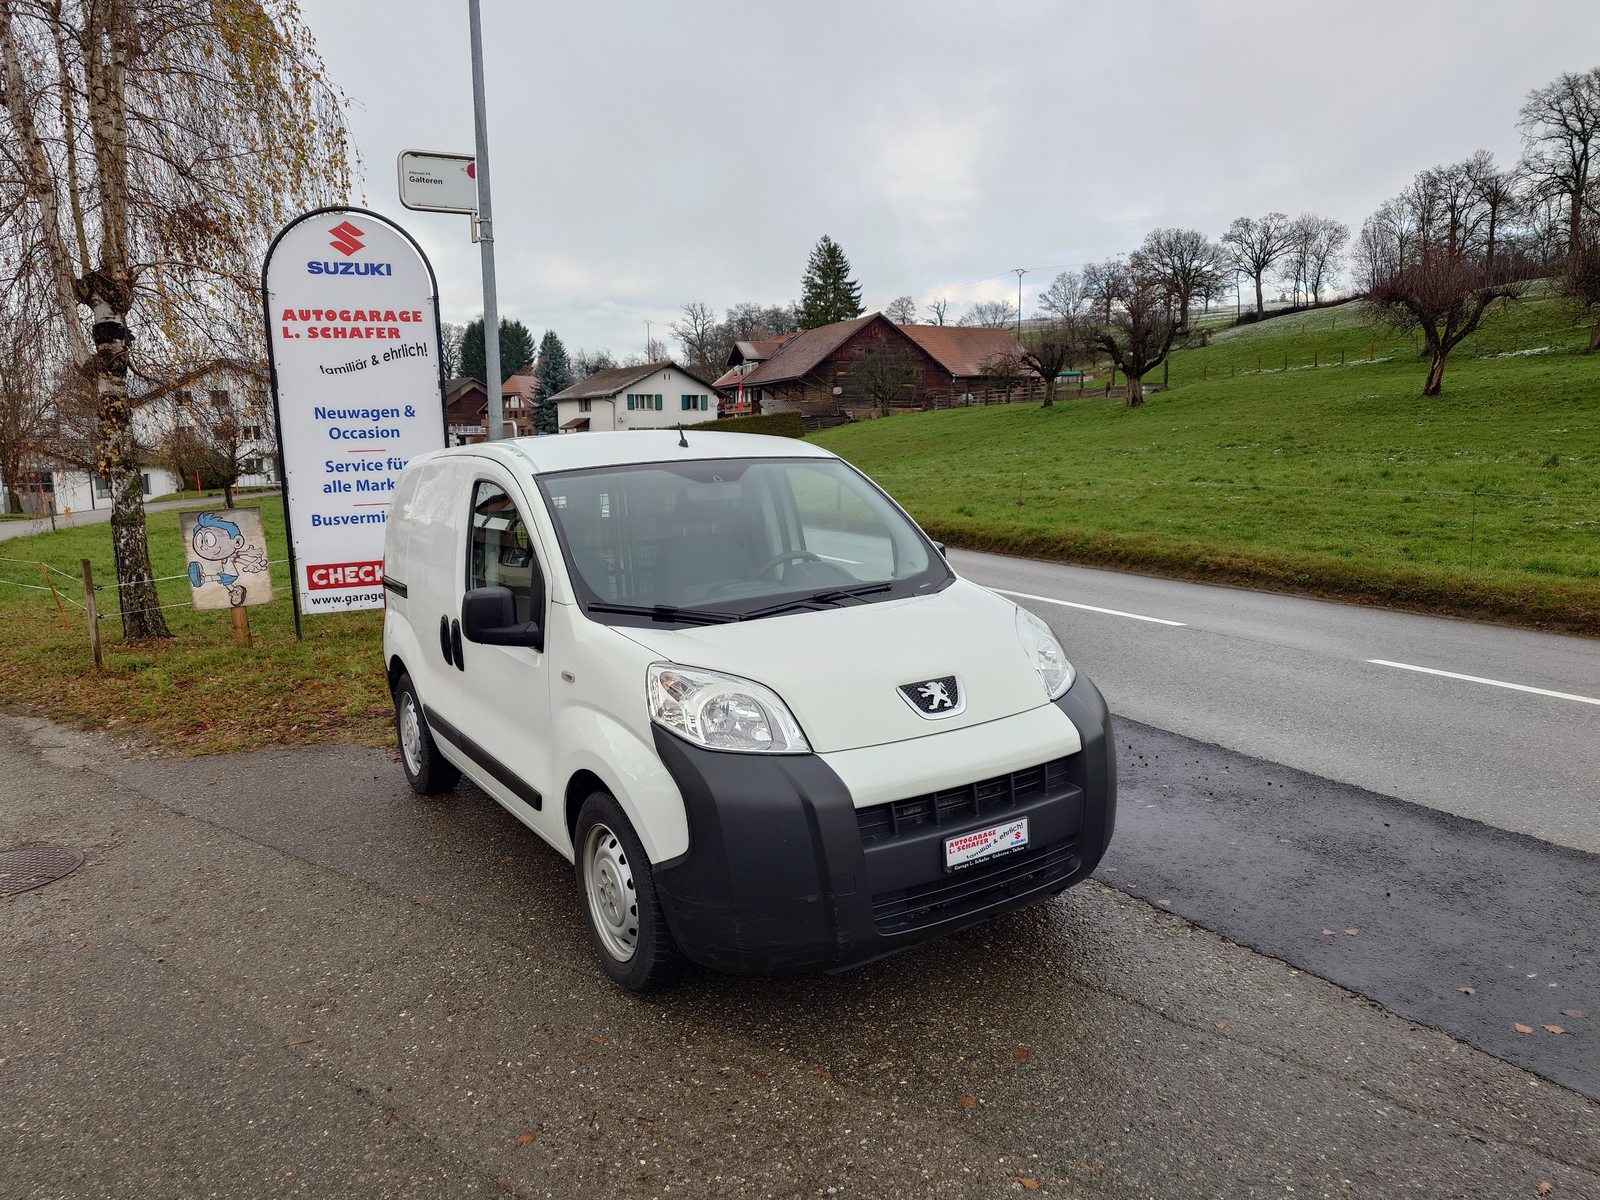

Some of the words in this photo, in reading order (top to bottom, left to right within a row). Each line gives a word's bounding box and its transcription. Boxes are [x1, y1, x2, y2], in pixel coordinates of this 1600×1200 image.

[409, 176, 443, 184] Galteren
[306, 261, 392, 276] SUZUKI
[281, 309, 423, 323] AUTOGARAGE
[282, 327, 300, 339] L.
[307, 326, 401, 339] SCHAFER
[319, 359, 368, 375] familiär
[371, 354, 380, 366] &
[382, 342, 428, 362] ehrlich!
[314, 406, 400, 421] Neuwagen
[404, 405, 416, 418] &
[328, 426, 400, 440] Occasion
[325, 459, 383, 473] Service
[323, 480, 352, 494] alle
[311, 510, 388, 527] Busvermi
[949, 830, 996, 848] AUTOGARAGE
[957, 838, 989, 852] SCHAFER
